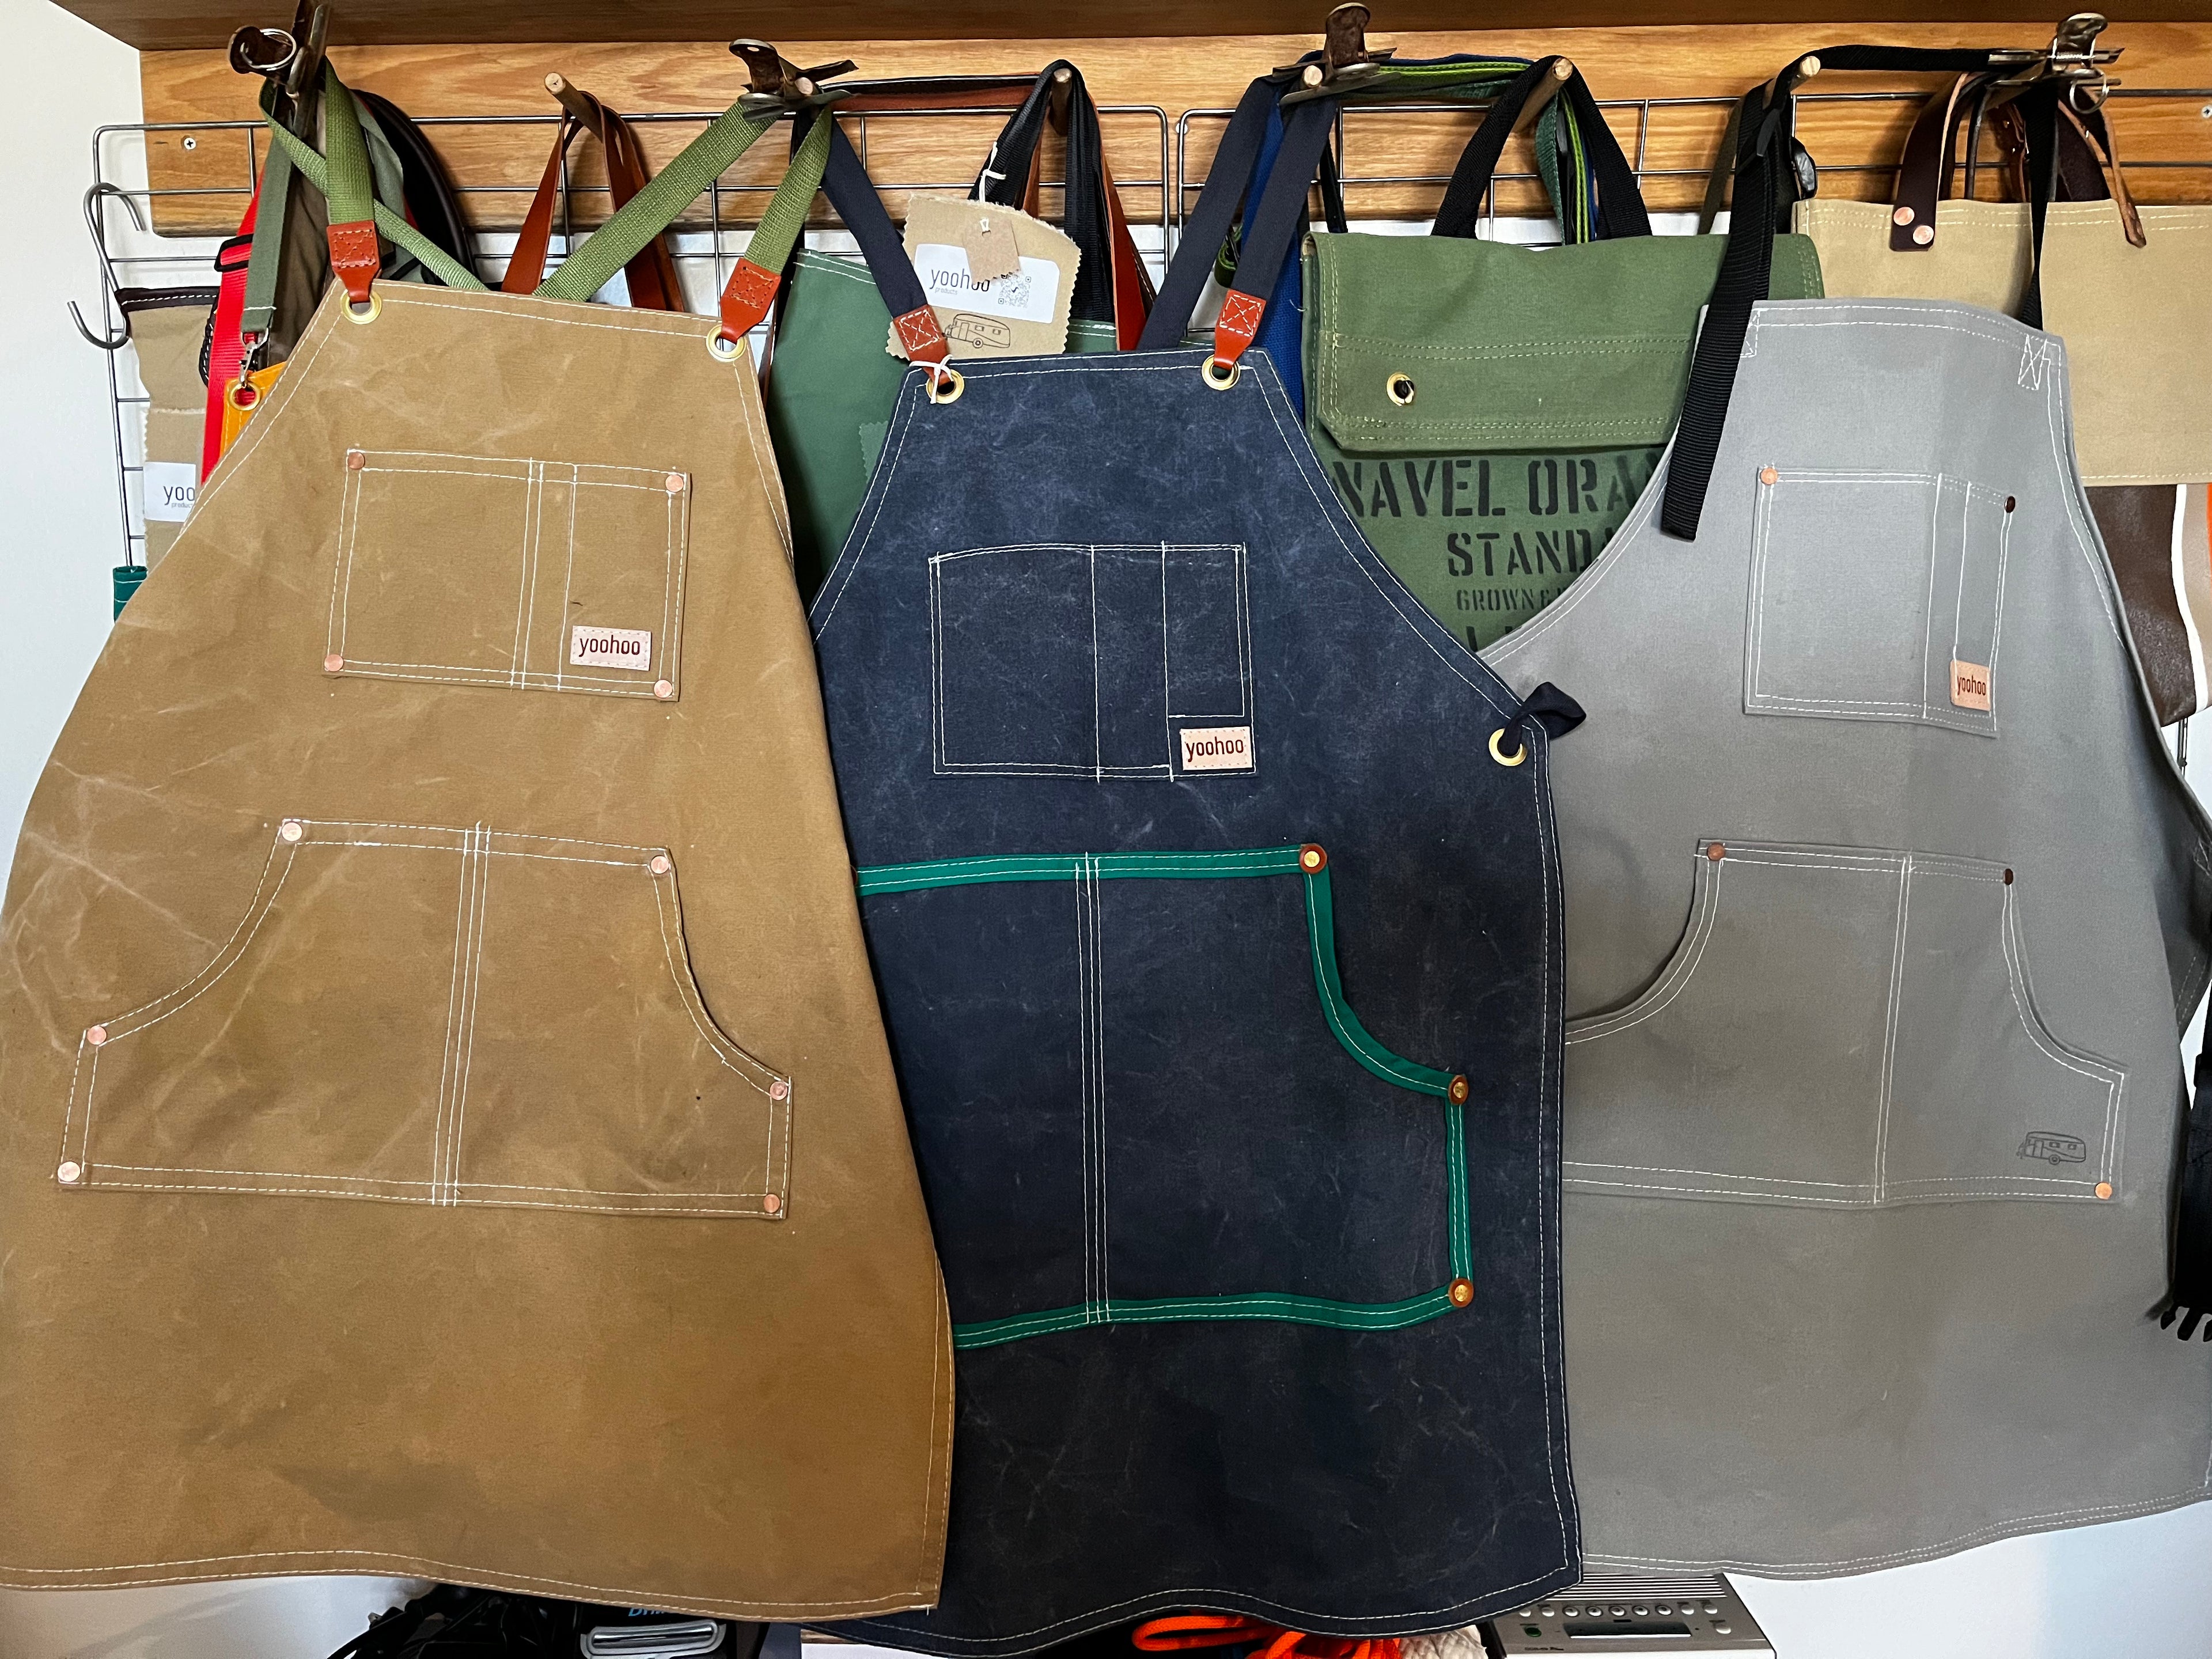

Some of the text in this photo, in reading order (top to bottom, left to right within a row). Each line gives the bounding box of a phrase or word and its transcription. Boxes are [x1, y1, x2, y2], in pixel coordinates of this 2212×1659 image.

[1332, 459, 1506, 518] NAVEL
[1456, 588, 1535, 611] GROWN
[578, 634, 641, 657] yoohoo
[1957, 674, 1987, 696] yoohoo
[1185, 736, 1244, 763] yoohoo
